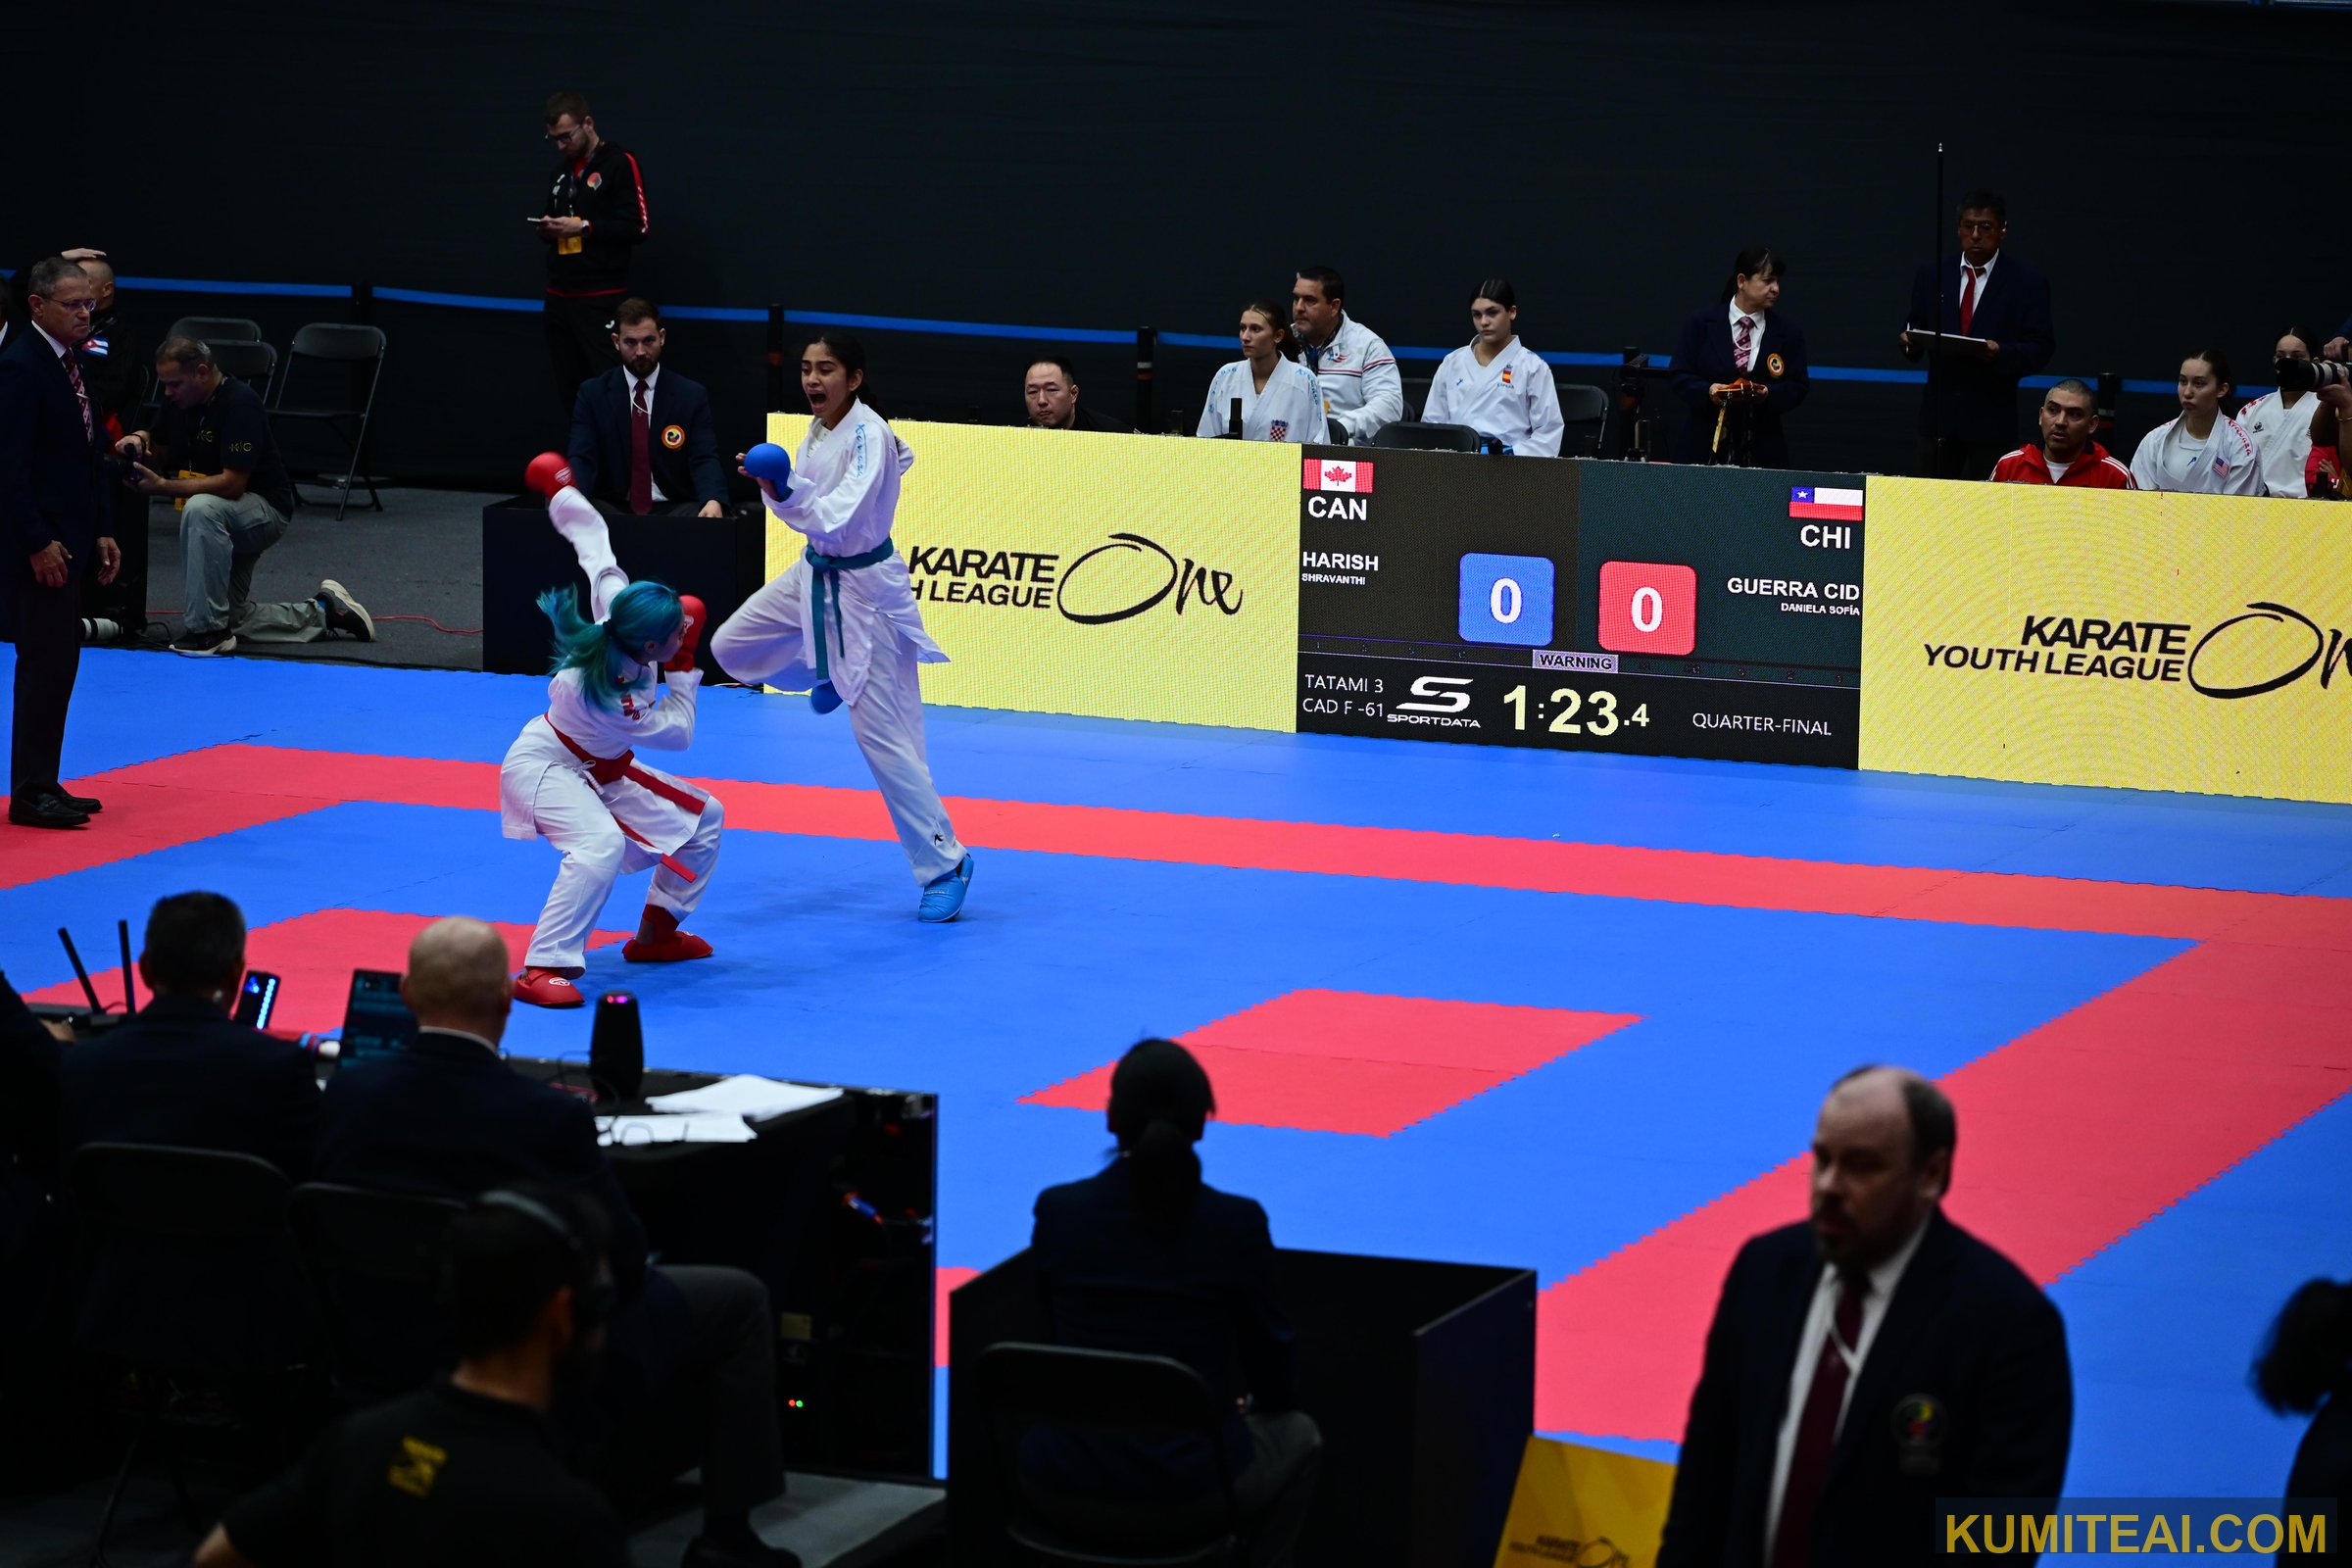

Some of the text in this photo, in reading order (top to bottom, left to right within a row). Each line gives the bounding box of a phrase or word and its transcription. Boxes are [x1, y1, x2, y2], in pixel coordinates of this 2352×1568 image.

[1307, 496, 1367, 521] CAN
[1799, 524, 1851, 550] CHI
[1302, 551, 1379, 571] HARISH
[908, 532, 1244, 625] KARATE One
[1301, 572, 1366, 586] SHRAVANTHI
[1727, 577, 1860, 601] GUERRA CID
[929, 580, 1054, 609] LEAGUE
[1490, 577, 1522, 624] 0
[1631, 586, 1663, 632] 0
[1781, 602, 1860, 616] DANIELA SOFÍA
[1539, 654, 1613, 672] WARNING
[1924, 643, 2184, 682] YOUTH LEAGUE
[2021, 601, 2352, 700] KARATE On
[1304, 673, 1384, 694] TATAMI 3
[1302, 697, 1384, 717] CAD F -61
[1387, 712, 1482, 729] SPORTDATA
[1691, 711, 1833, 736] QUARTER-FINAL
